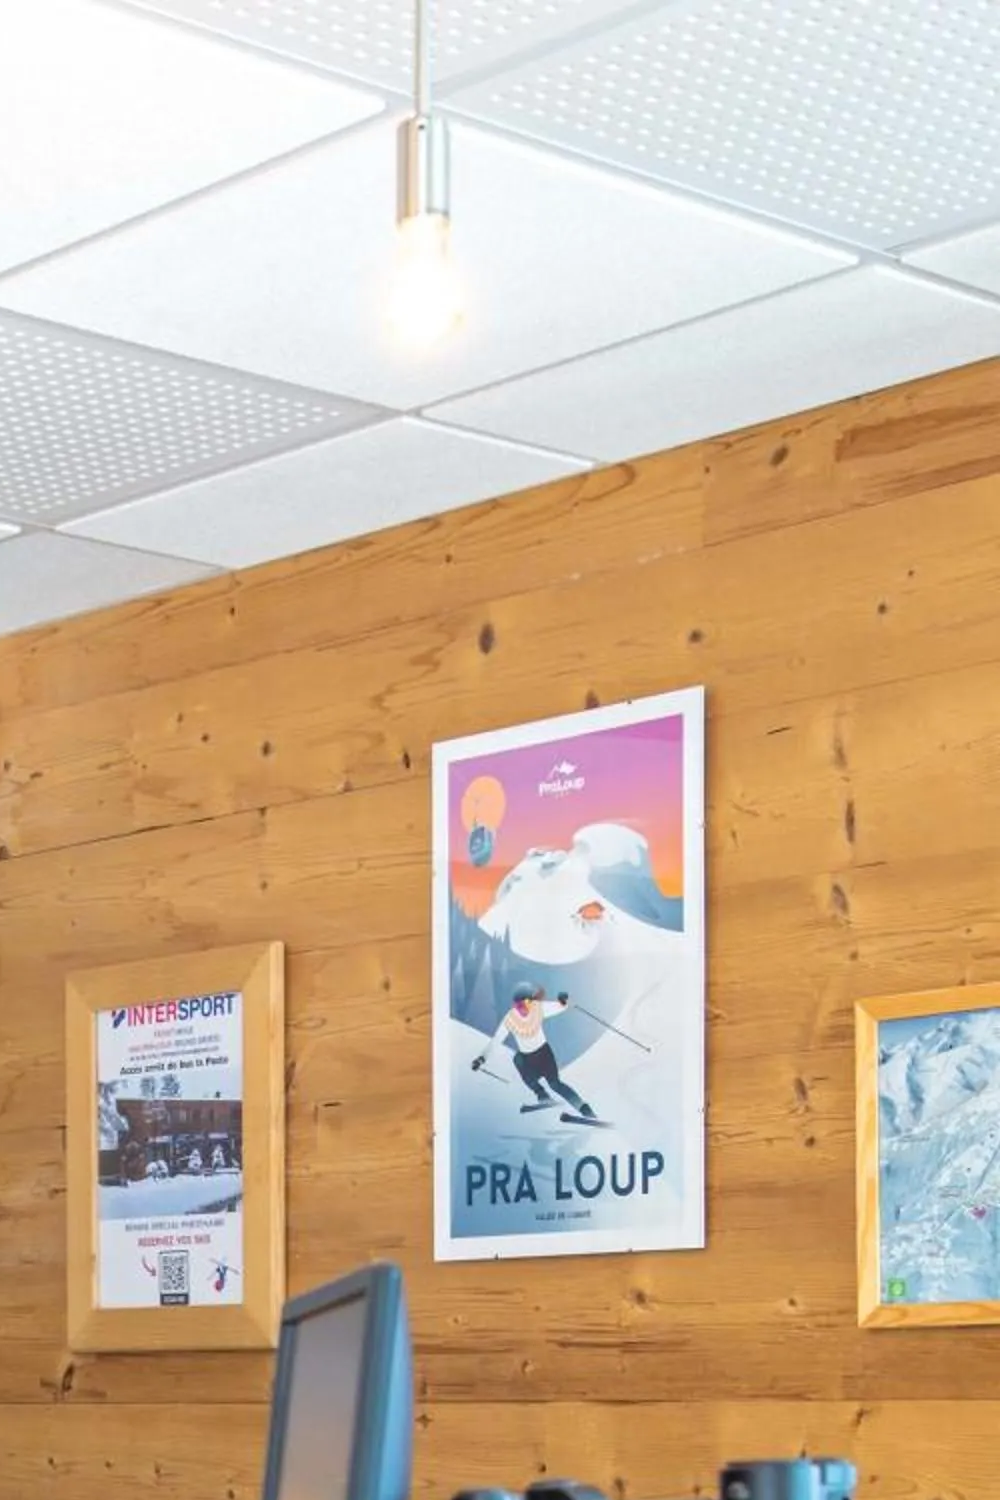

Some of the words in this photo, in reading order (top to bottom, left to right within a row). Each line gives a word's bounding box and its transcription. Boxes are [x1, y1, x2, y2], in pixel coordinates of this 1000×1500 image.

[127, 993, 235, 1027] INTERSPORT
[466, 1160, 537, 1206] PRA
[555, 1150, 664, 1200] LOUP
